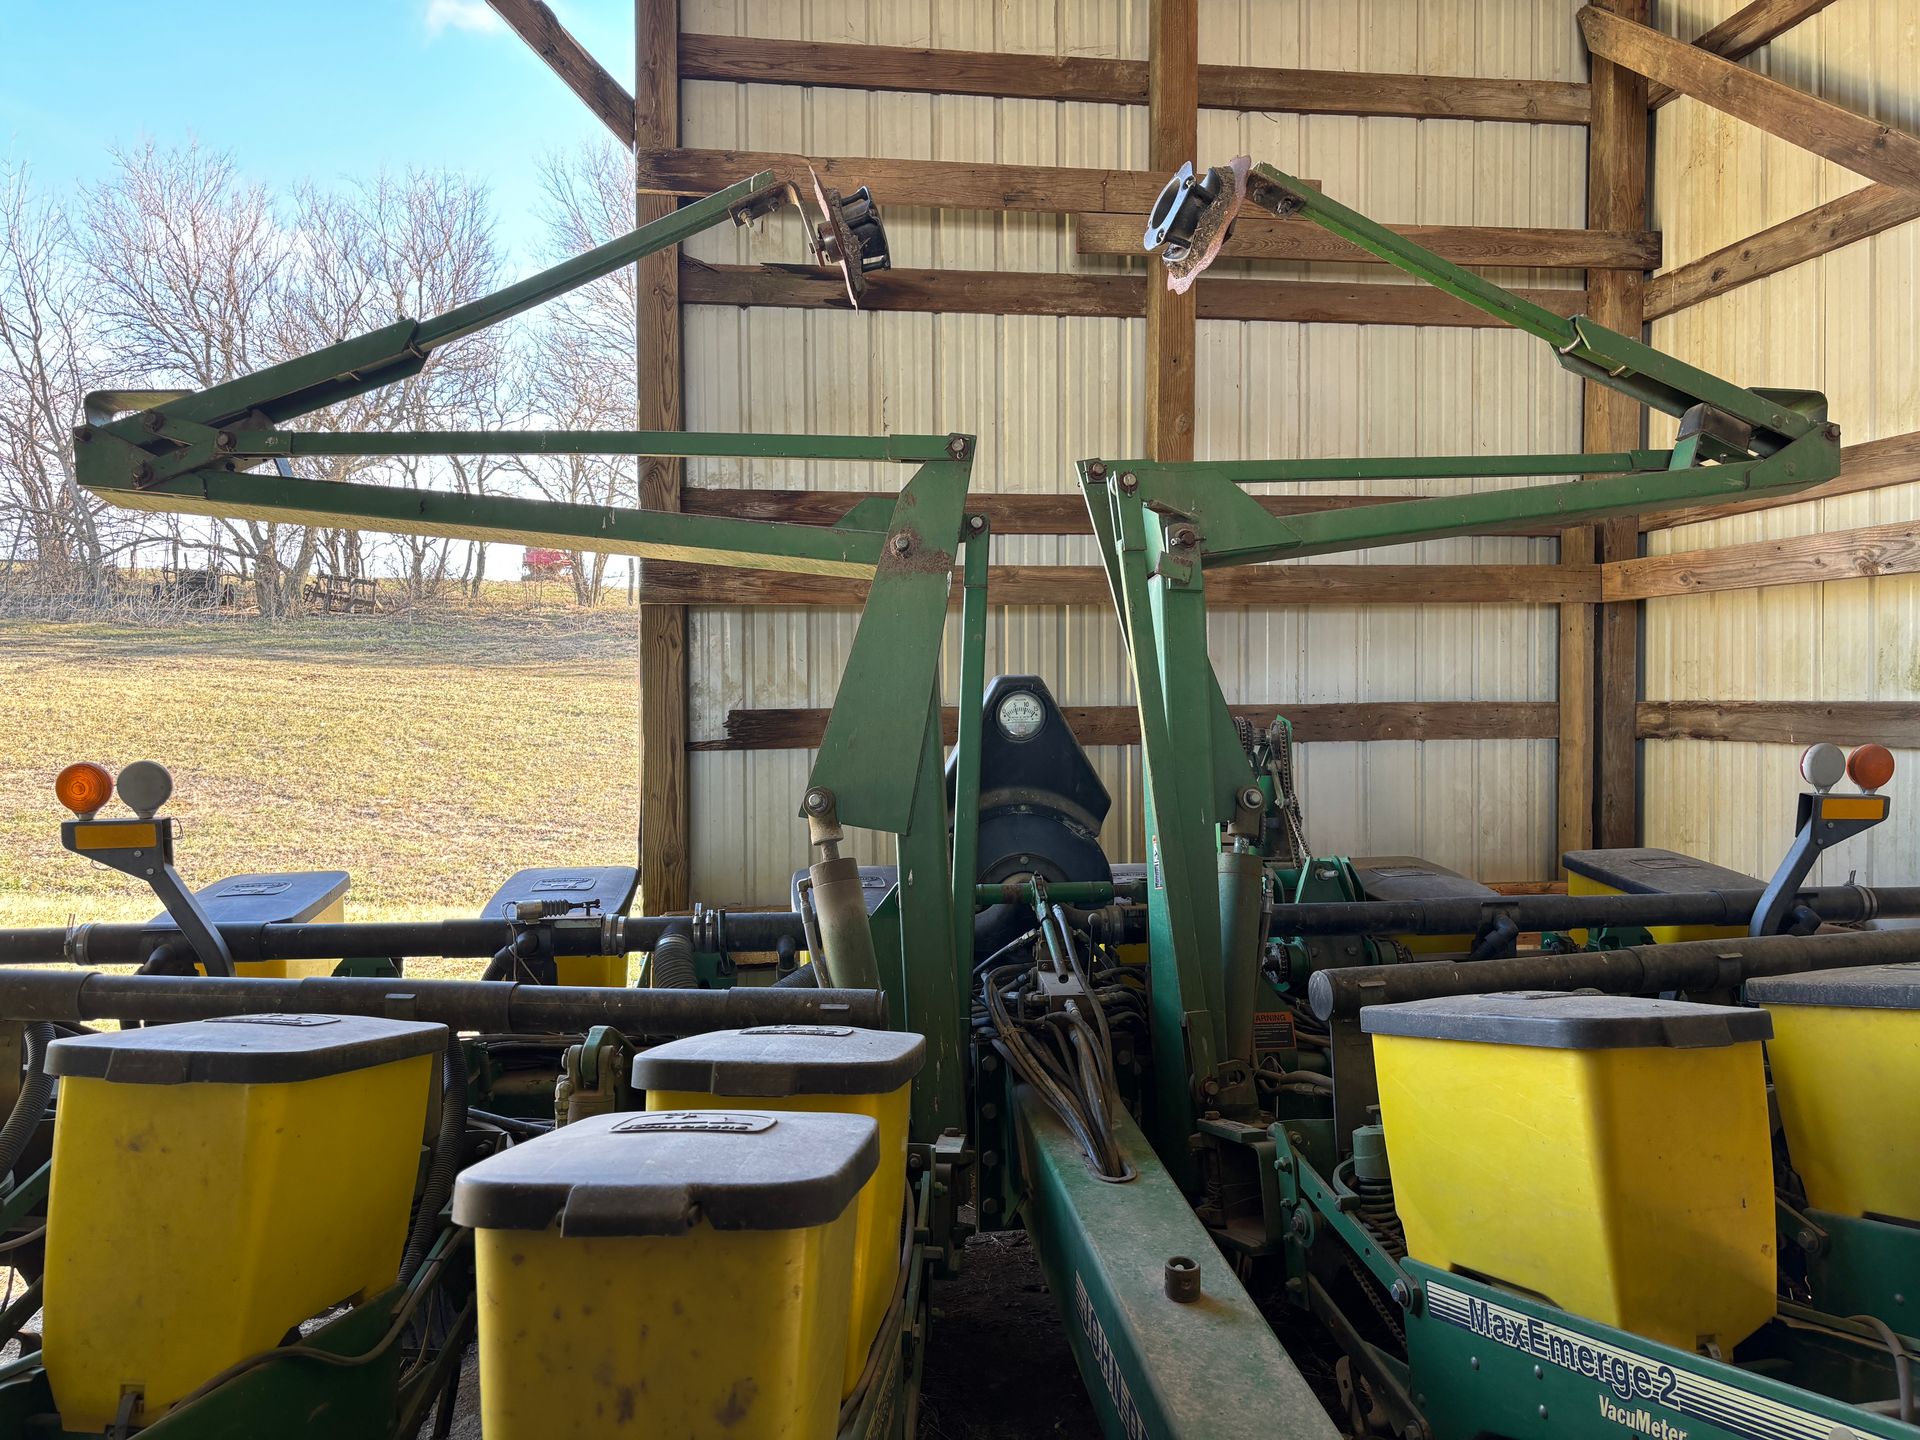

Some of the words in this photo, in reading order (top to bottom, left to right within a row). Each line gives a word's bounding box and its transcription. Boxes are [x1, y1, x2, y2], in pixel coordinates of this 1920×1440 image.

[1255, 1014, 1286, 1022] ARNING
[1082, 1296, 1123, 1416] JOHN
[1599, 1394, 1688, 1440] VacuMeter
